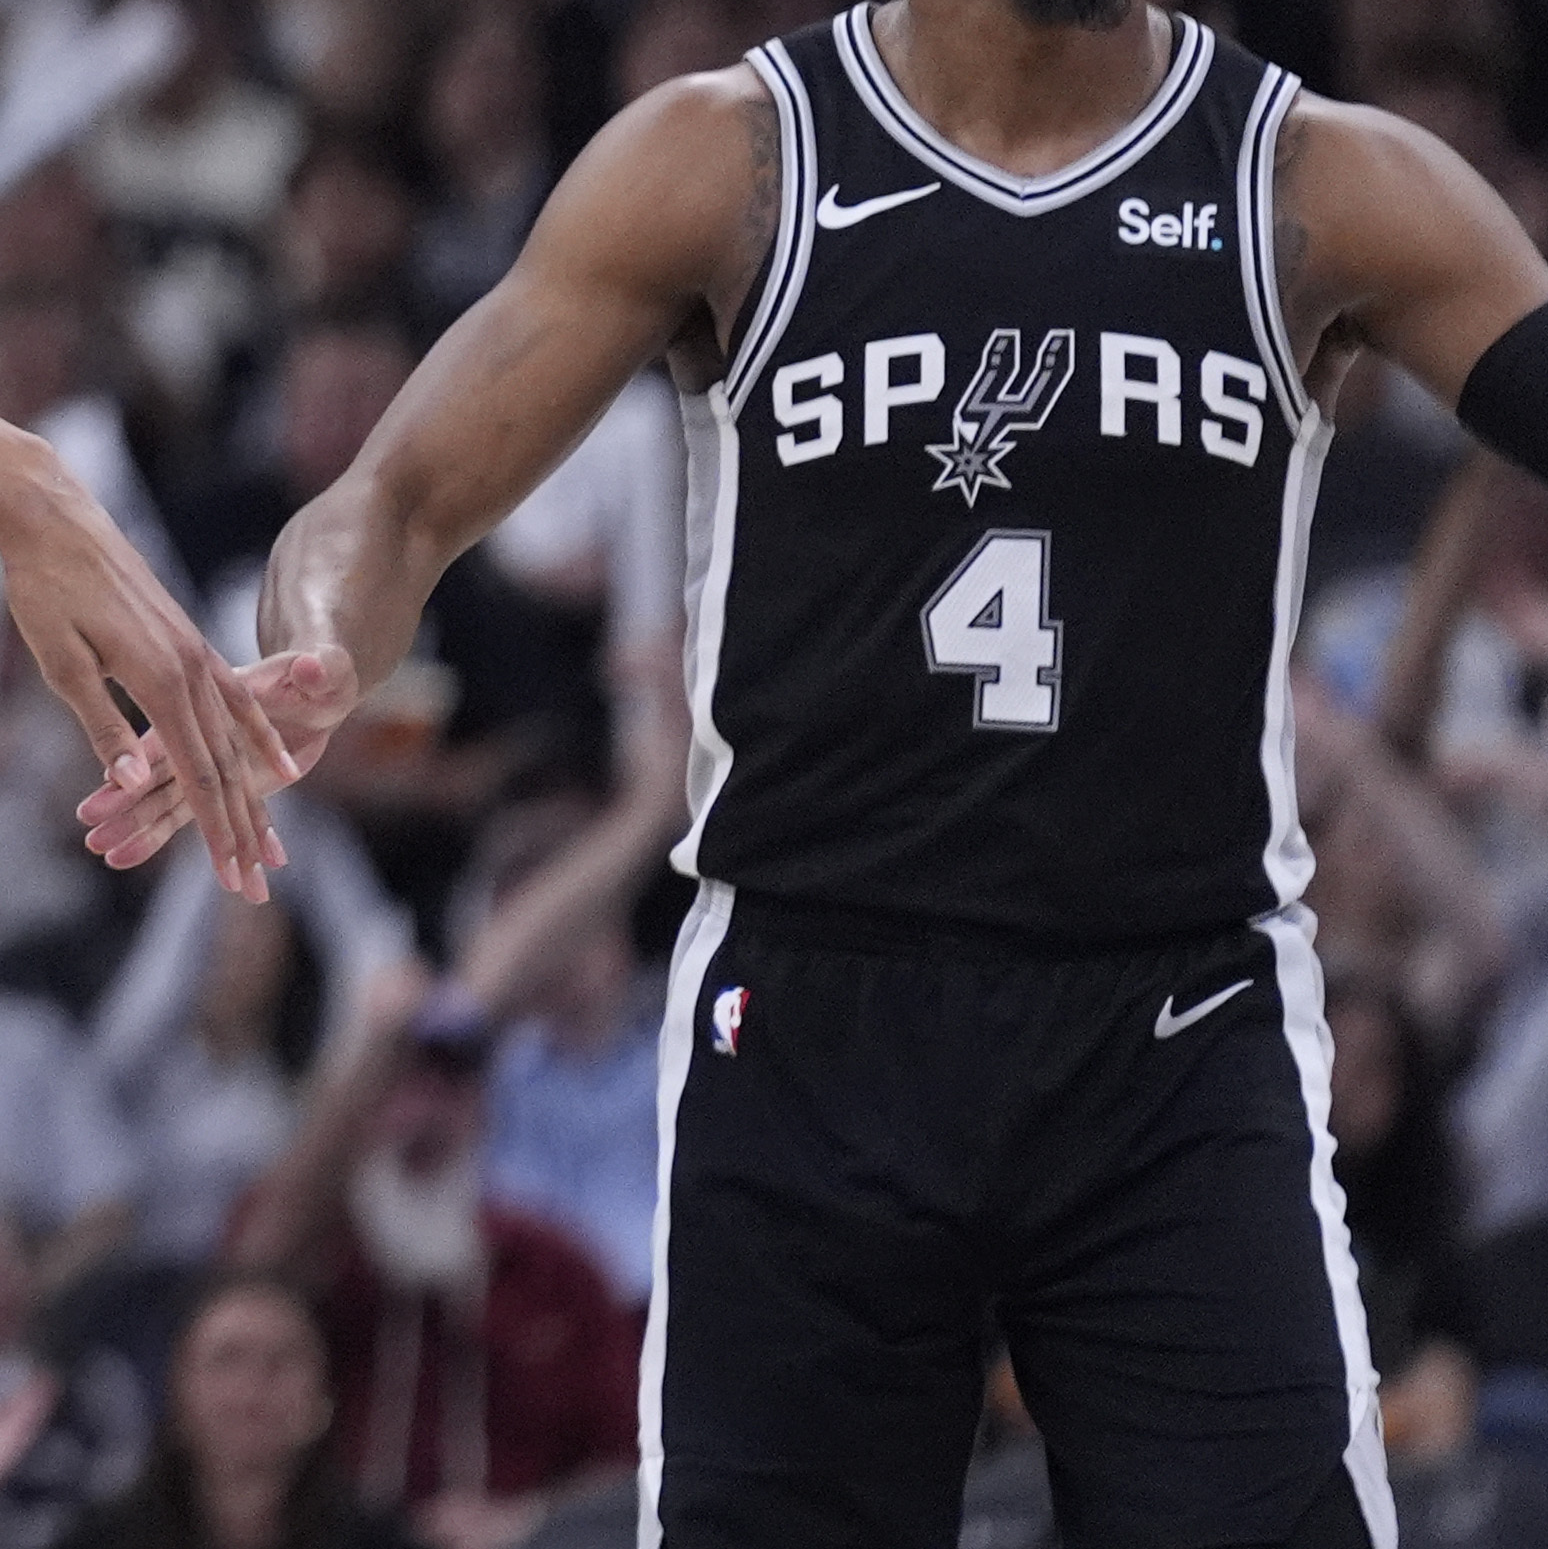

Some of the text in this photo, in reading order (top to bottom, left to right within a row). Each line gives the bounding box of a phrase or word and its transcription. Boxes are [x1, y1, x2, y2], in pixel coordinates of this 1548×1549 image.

[1117, 198, 1223, 251] Self.
[772, 328, 1268, 509] SPURS
[920, 529, 1064, 733] 4
